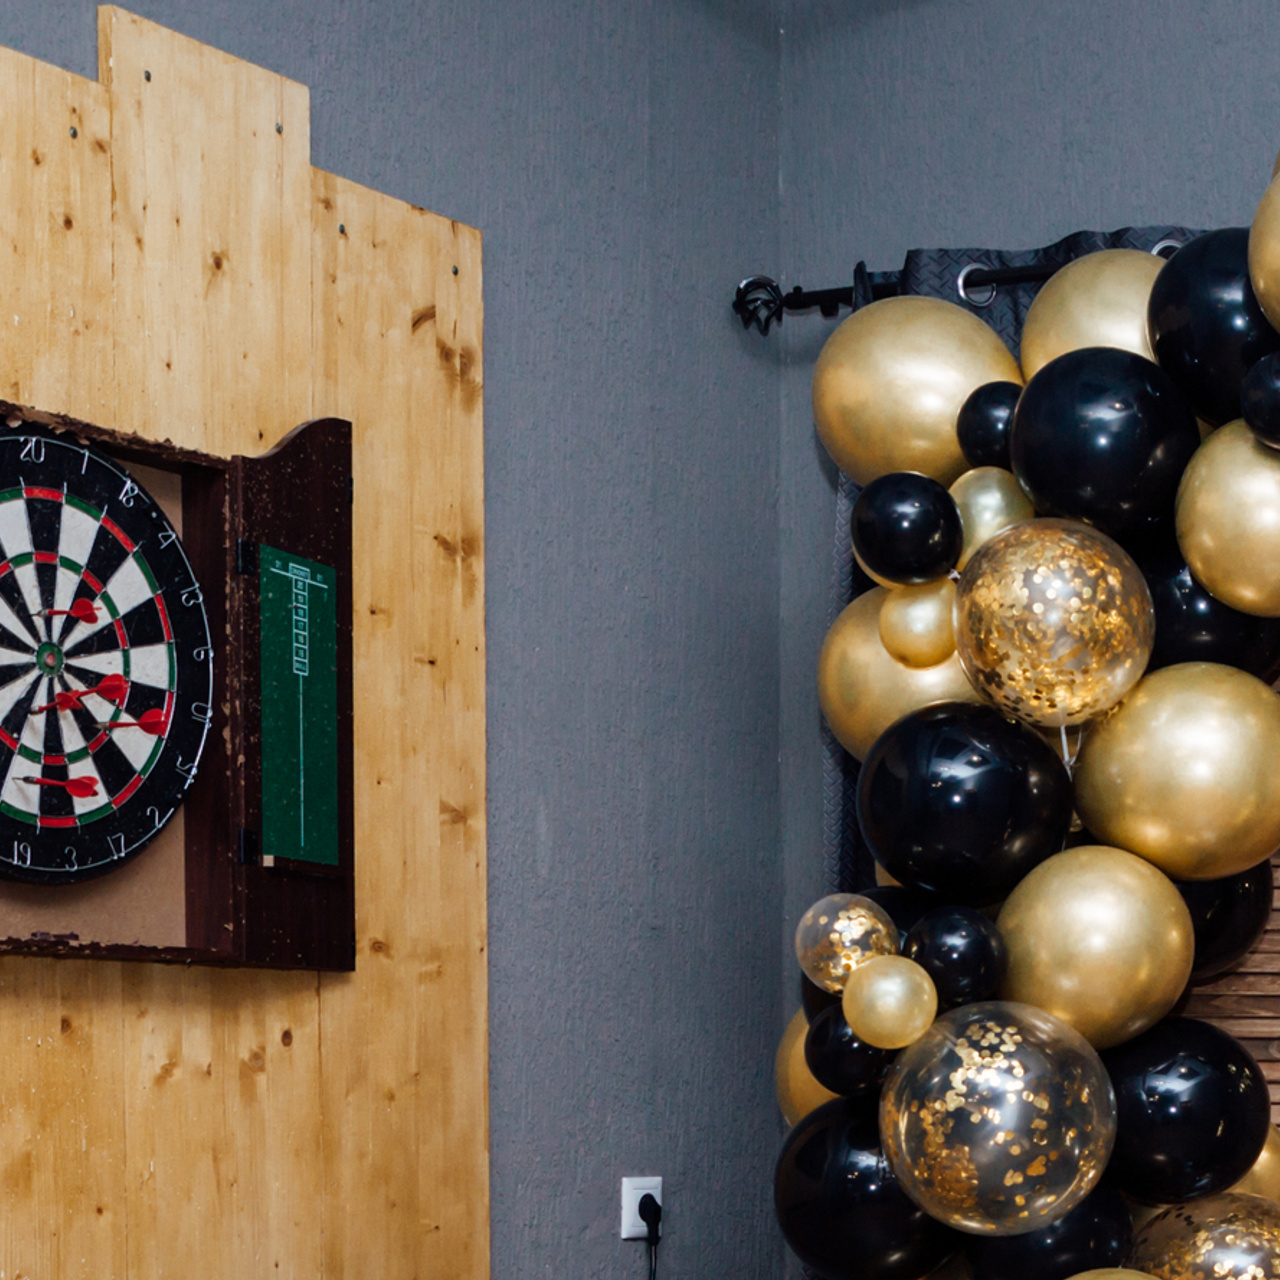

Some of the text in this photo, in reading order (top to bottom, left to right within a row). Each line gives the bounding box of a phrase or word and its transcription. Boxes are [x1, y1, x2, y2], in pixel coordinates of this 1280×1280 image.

[20, 437, 45, 463] 20
[80, 449, 90, 474] 1
[119, 478, 138, 508] 18
[158, 521, 176, 549] 4
[181, 584, 203, 607] 13
[191, 702, 213, 728] 10
[13, 840, 31, 867] 19
[64, 847, 78, 872] 3
[107, 833, 125, 860] 17
